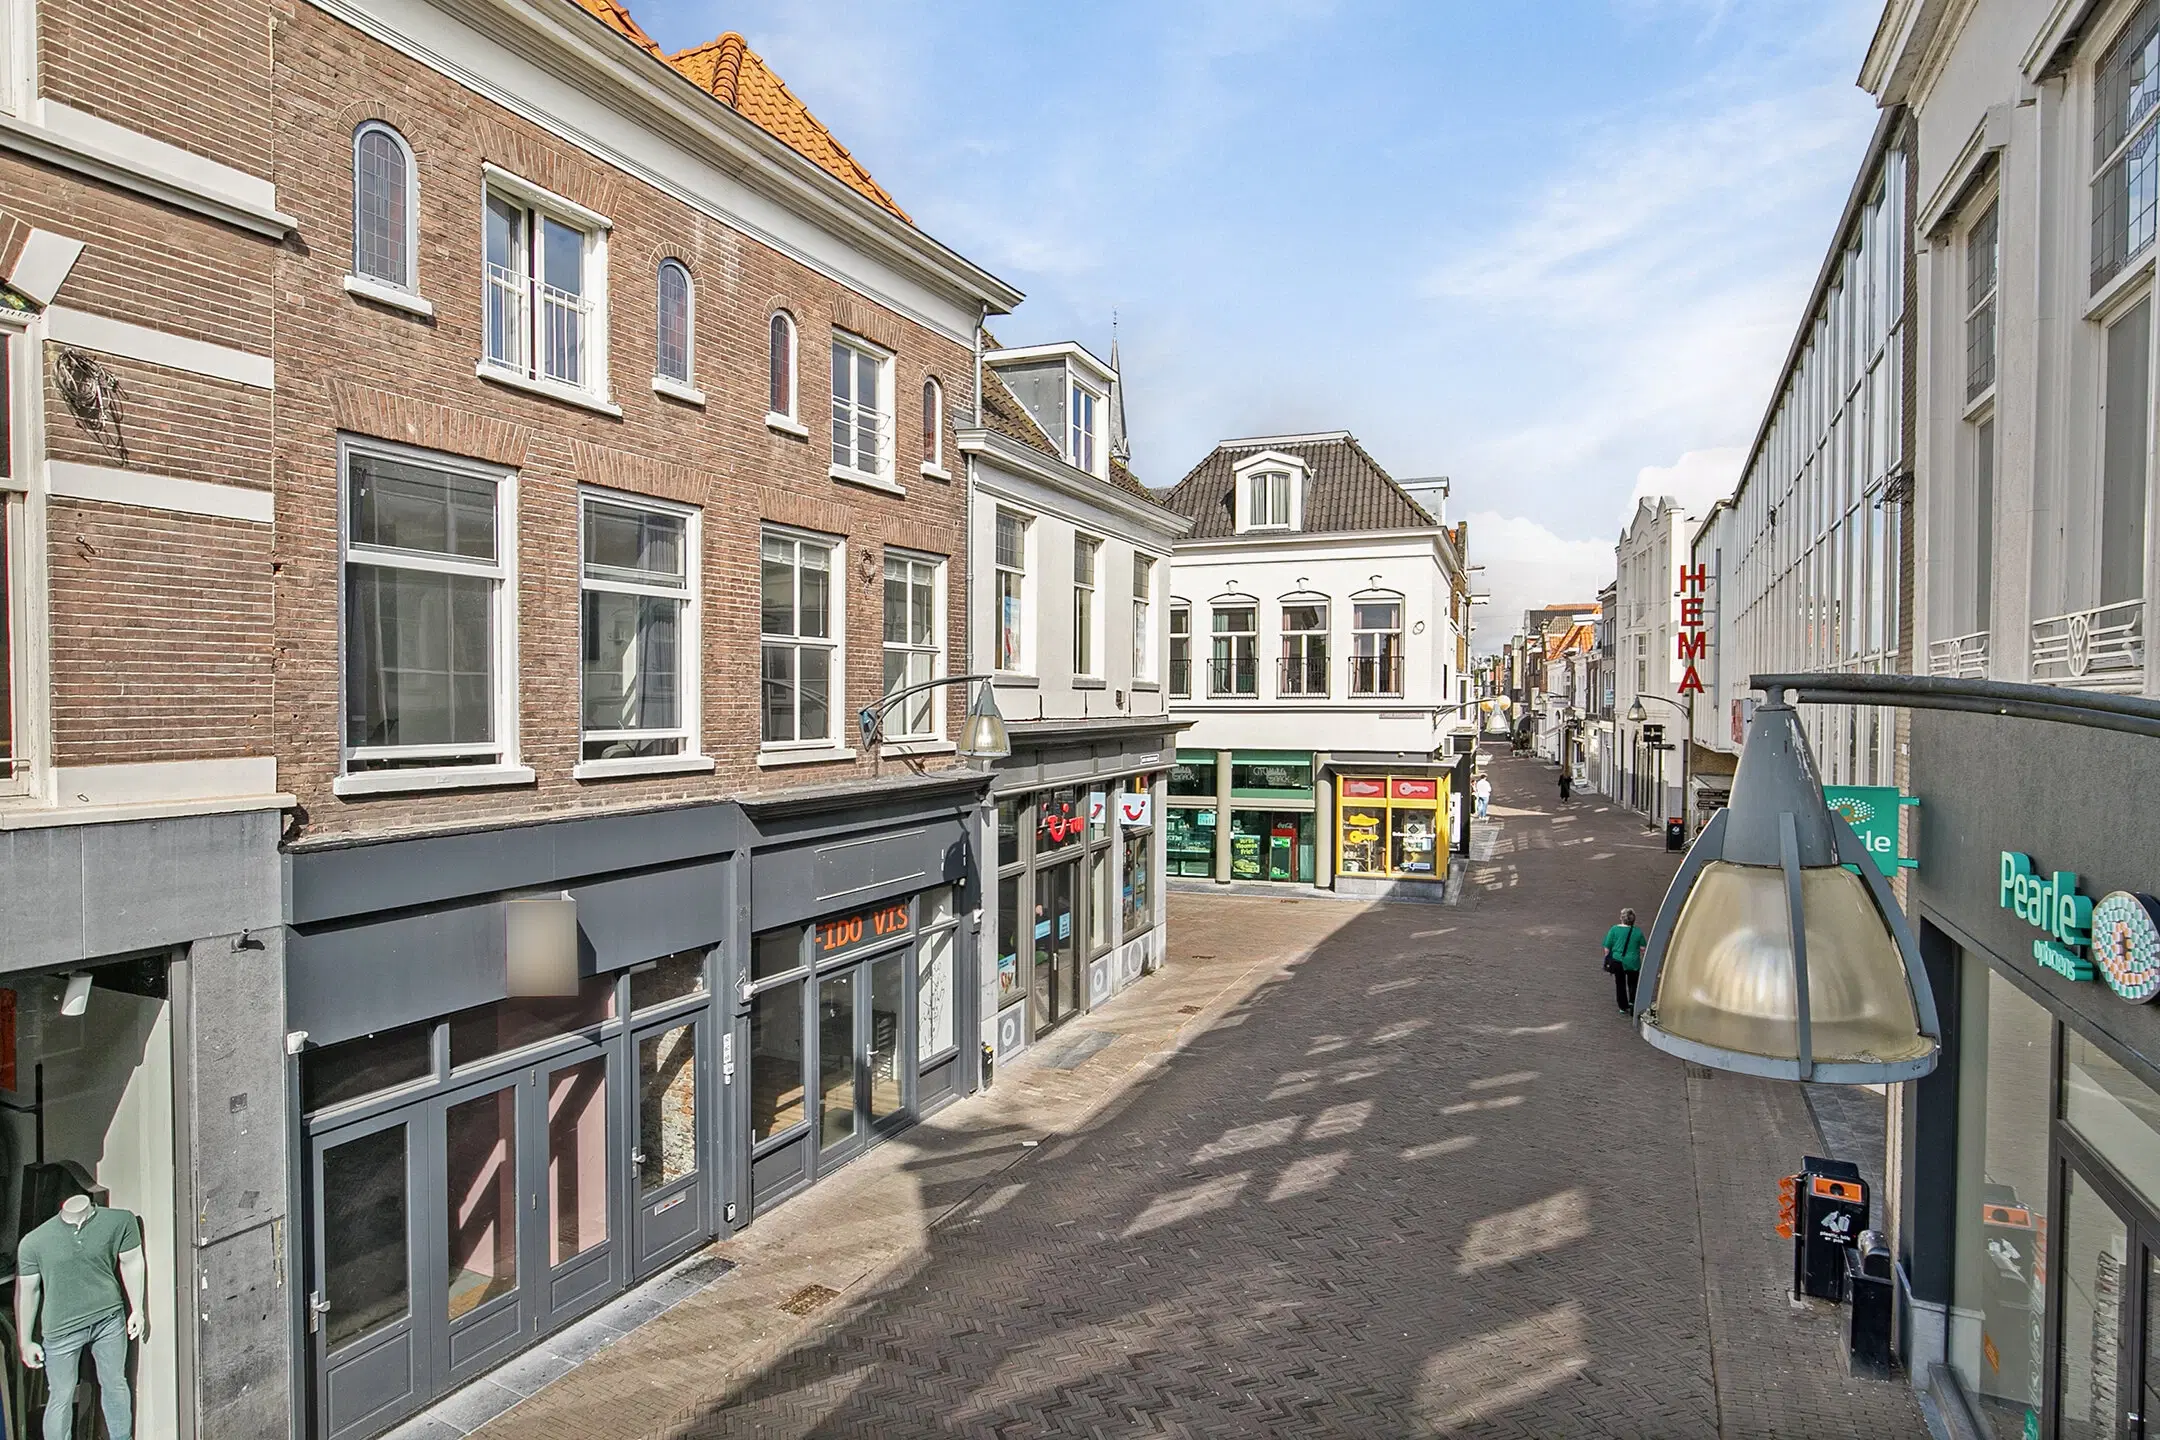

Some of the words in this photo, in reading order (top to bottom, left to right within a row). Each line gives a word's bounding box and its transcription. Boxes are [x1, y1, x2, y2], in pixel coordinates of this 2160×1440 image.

[1678, 563, 1706, 693] HEMA
[873, 903, 910, 935] VIS
[2000, 850, 2078, 946] Pearle
